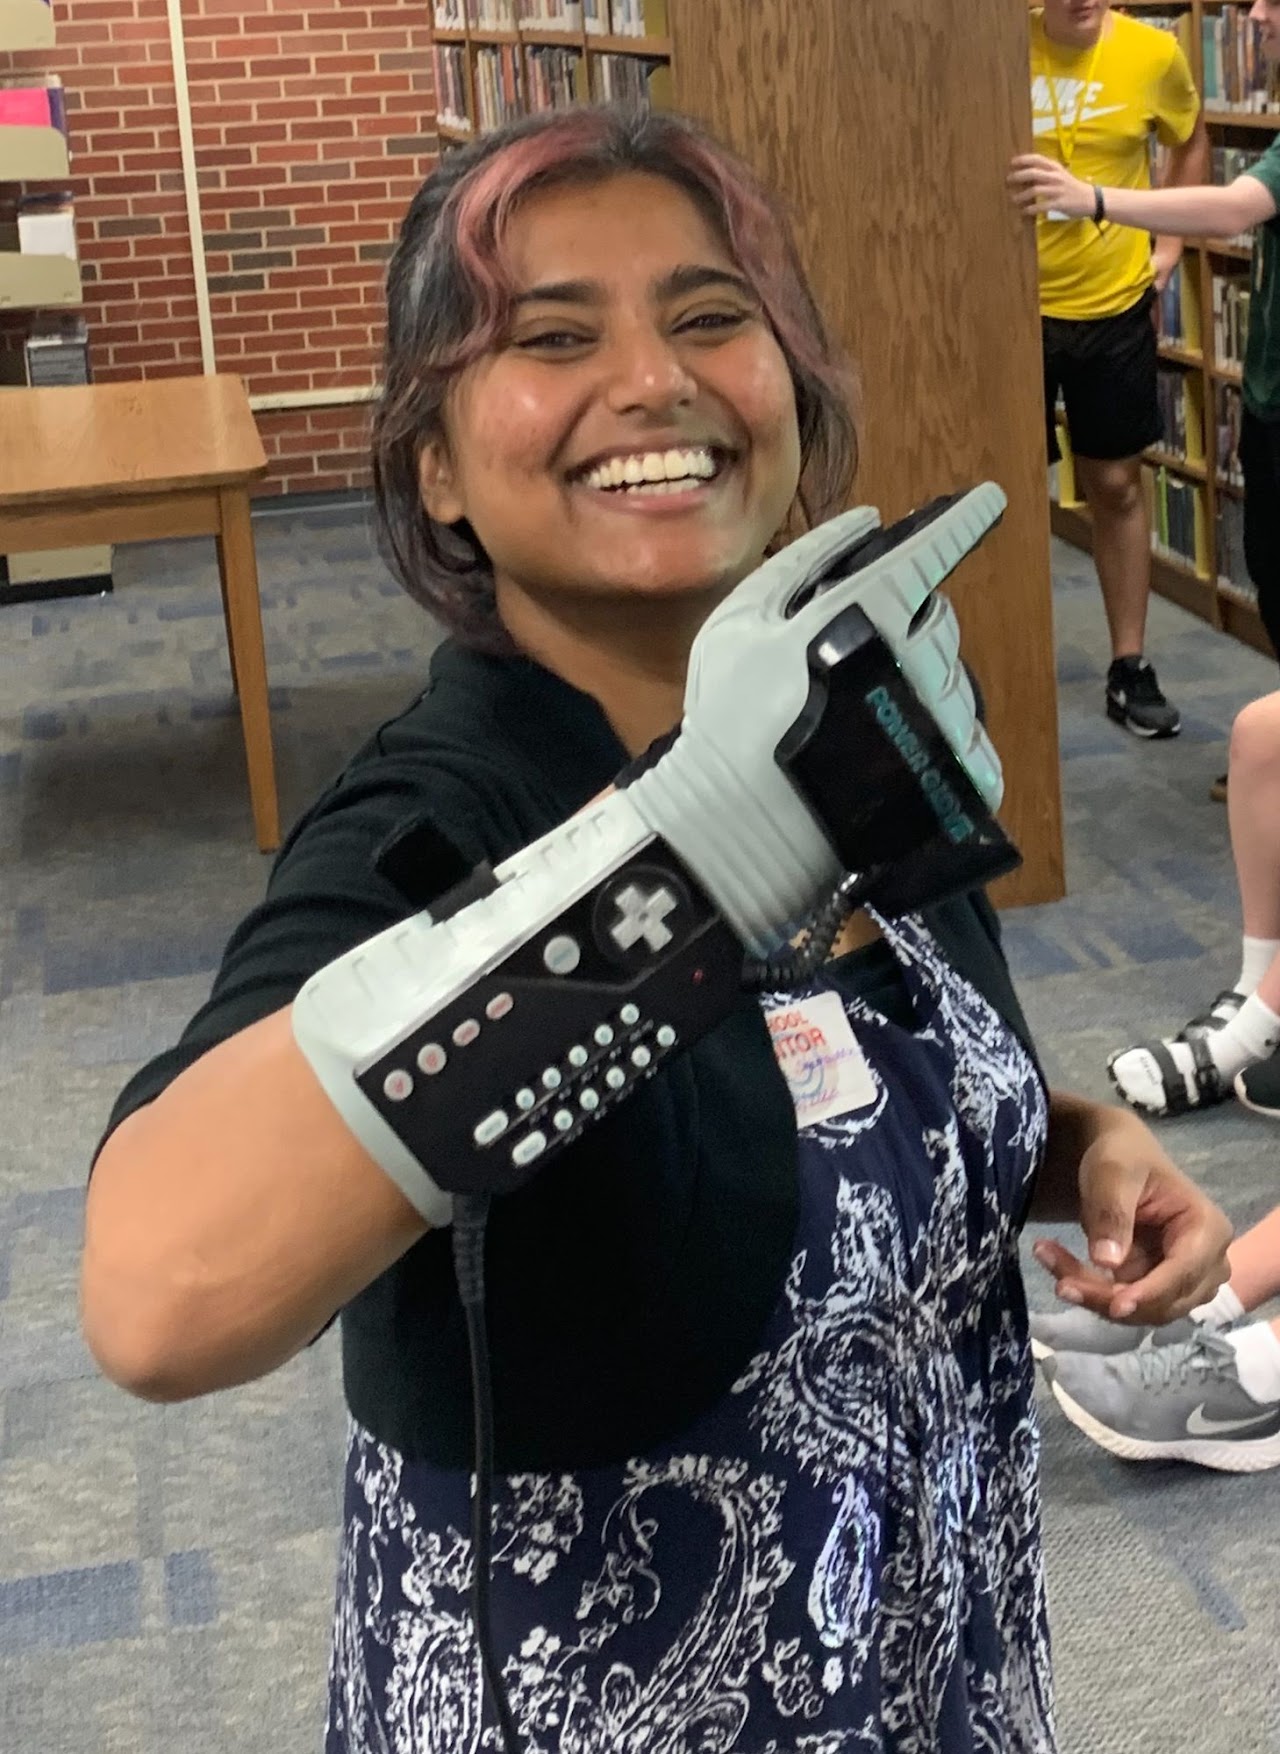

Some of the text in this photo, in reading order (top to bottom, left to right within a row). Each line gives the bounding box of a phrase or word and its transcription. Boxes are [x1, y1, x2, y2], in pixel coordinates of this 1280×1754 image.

[1030, 75, 1104, 113] NIKE
[866, 686, 930, 773] POWER
[774, 1027, 827, 1060] ITOR
